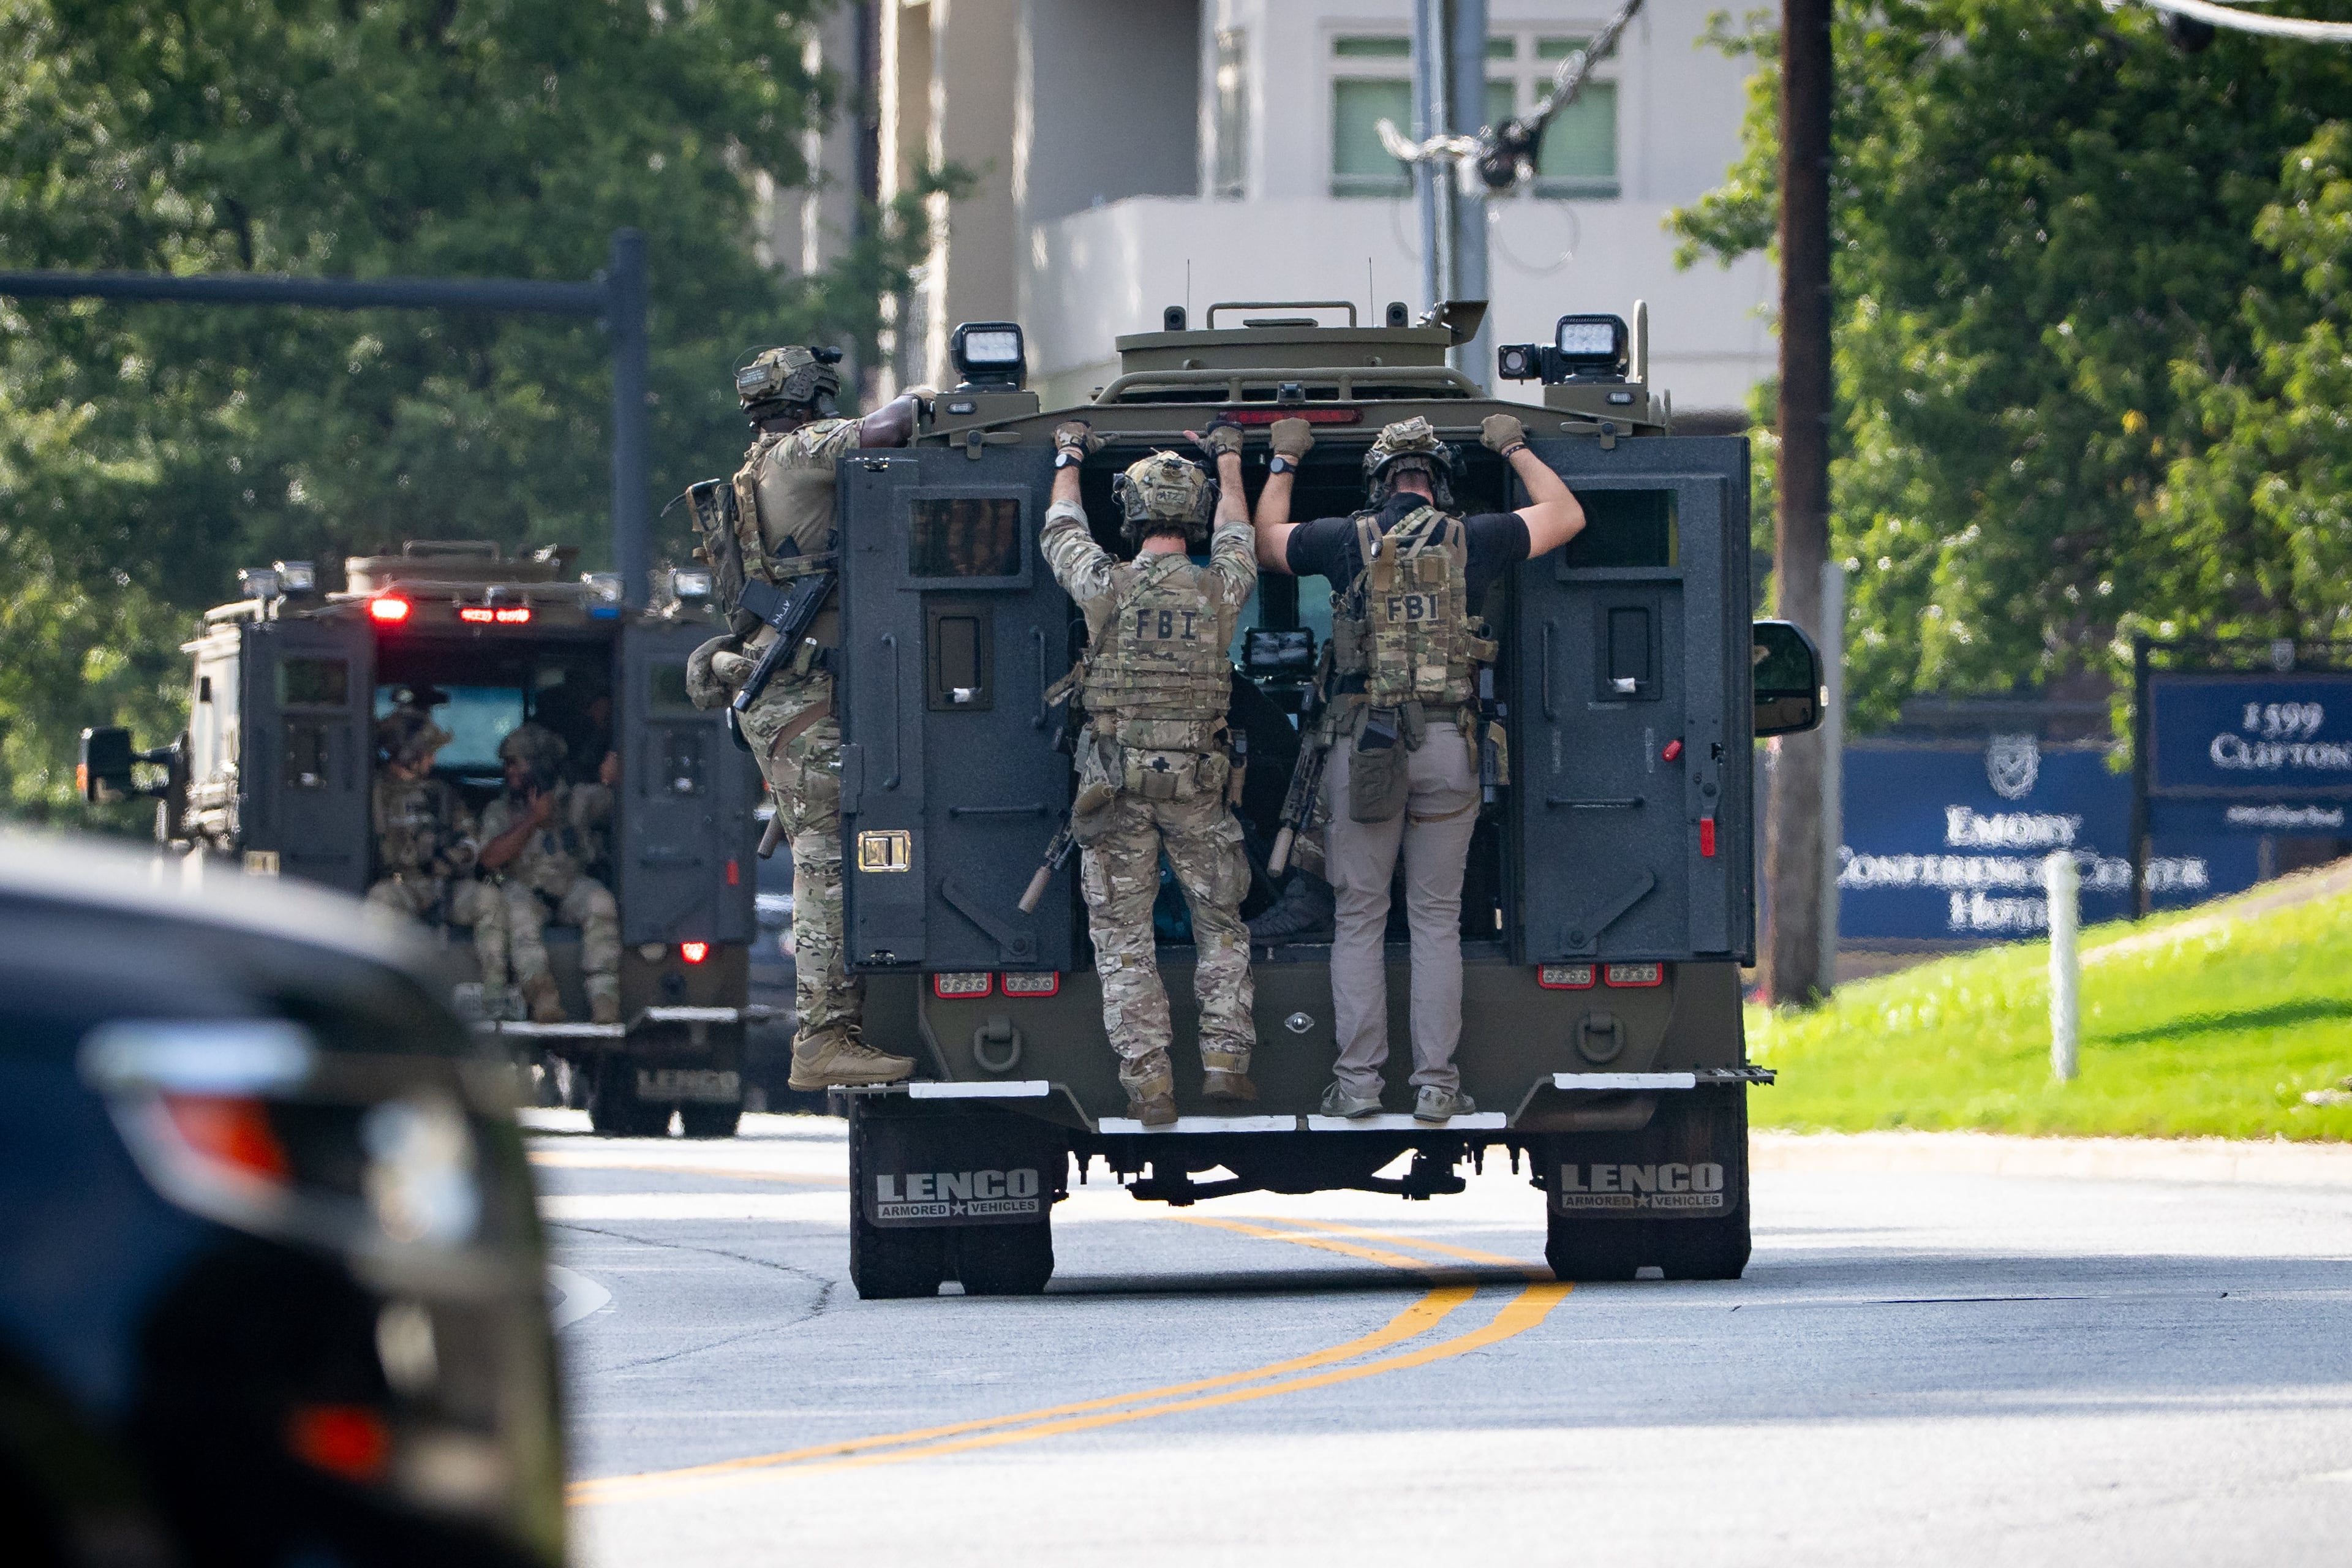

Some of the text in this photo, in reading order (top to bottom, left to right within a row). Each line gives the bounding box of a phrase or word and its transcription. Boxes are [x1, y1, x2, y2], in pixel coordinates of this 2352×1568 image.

[1387, 595, 1438, 622] FBI
[1136, 608, 1199, 640] FBI
[2242, 702, 2324, 737] 1599
[1949, 890, 2048, 929] HOTE
[876, 1168, 1039, 1202] LENCO
[1561, 1163, 1724, 1192] LENCO
[881, 1200, 1036, 1216] ARMORED VEHICLES
[1566, 1195, 1720, 1206] ARMORED VEHICLES
